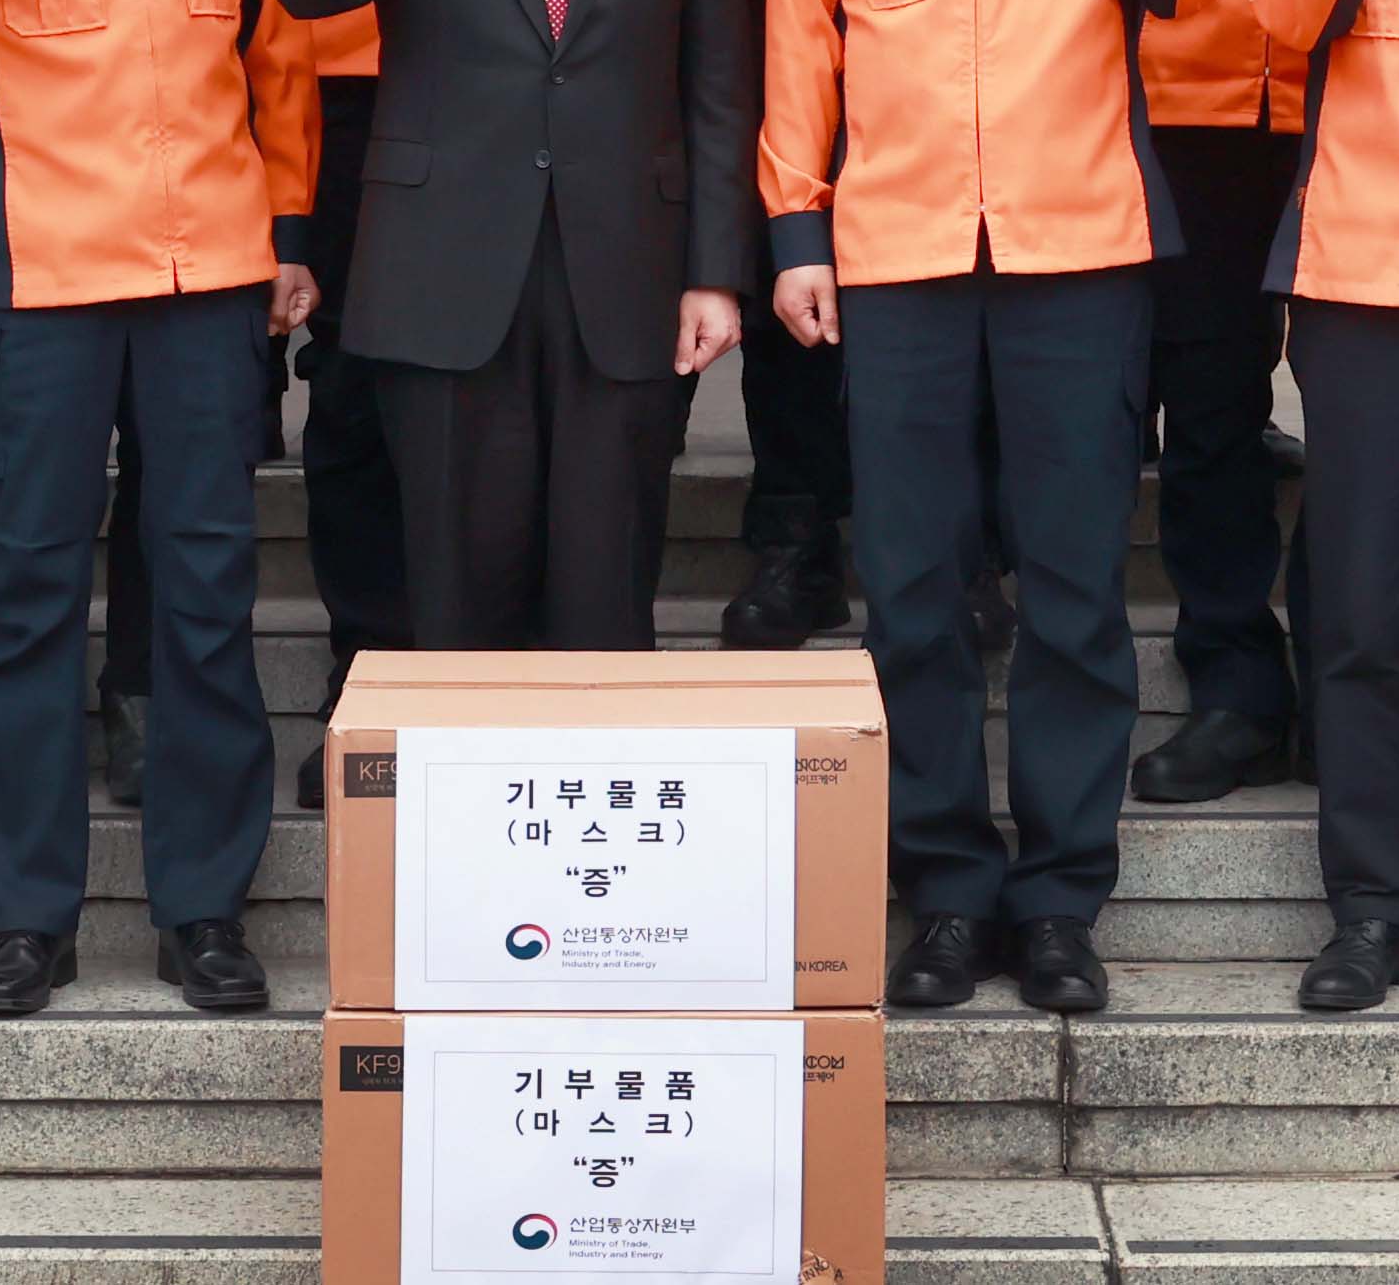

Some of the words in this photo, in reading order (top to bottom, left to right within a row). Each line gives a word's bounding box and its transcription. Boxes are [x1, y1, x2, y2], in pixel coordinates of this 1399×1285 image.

[562, 926, 689, 944] 산업통상자원부
[562, 949, 599, 959] Ministry
[601, 949, 611, 958] of
[562, 960, 600, 971] Industry
[603, 960, 621, 969] and
[624, 960, 657, 970] Energy
[809, 961, 848, 972] KOREA
[569, 1216, 697, 1235] 산업통상자원부
[569, 1239, 606, 1249] Ministry
[608, 1239, 619, 1248] of
[569, 1250, 607, 1260] Industry
[610, 1251, 628, 1260] and
[631, 1251, 664, 1261] Energy
